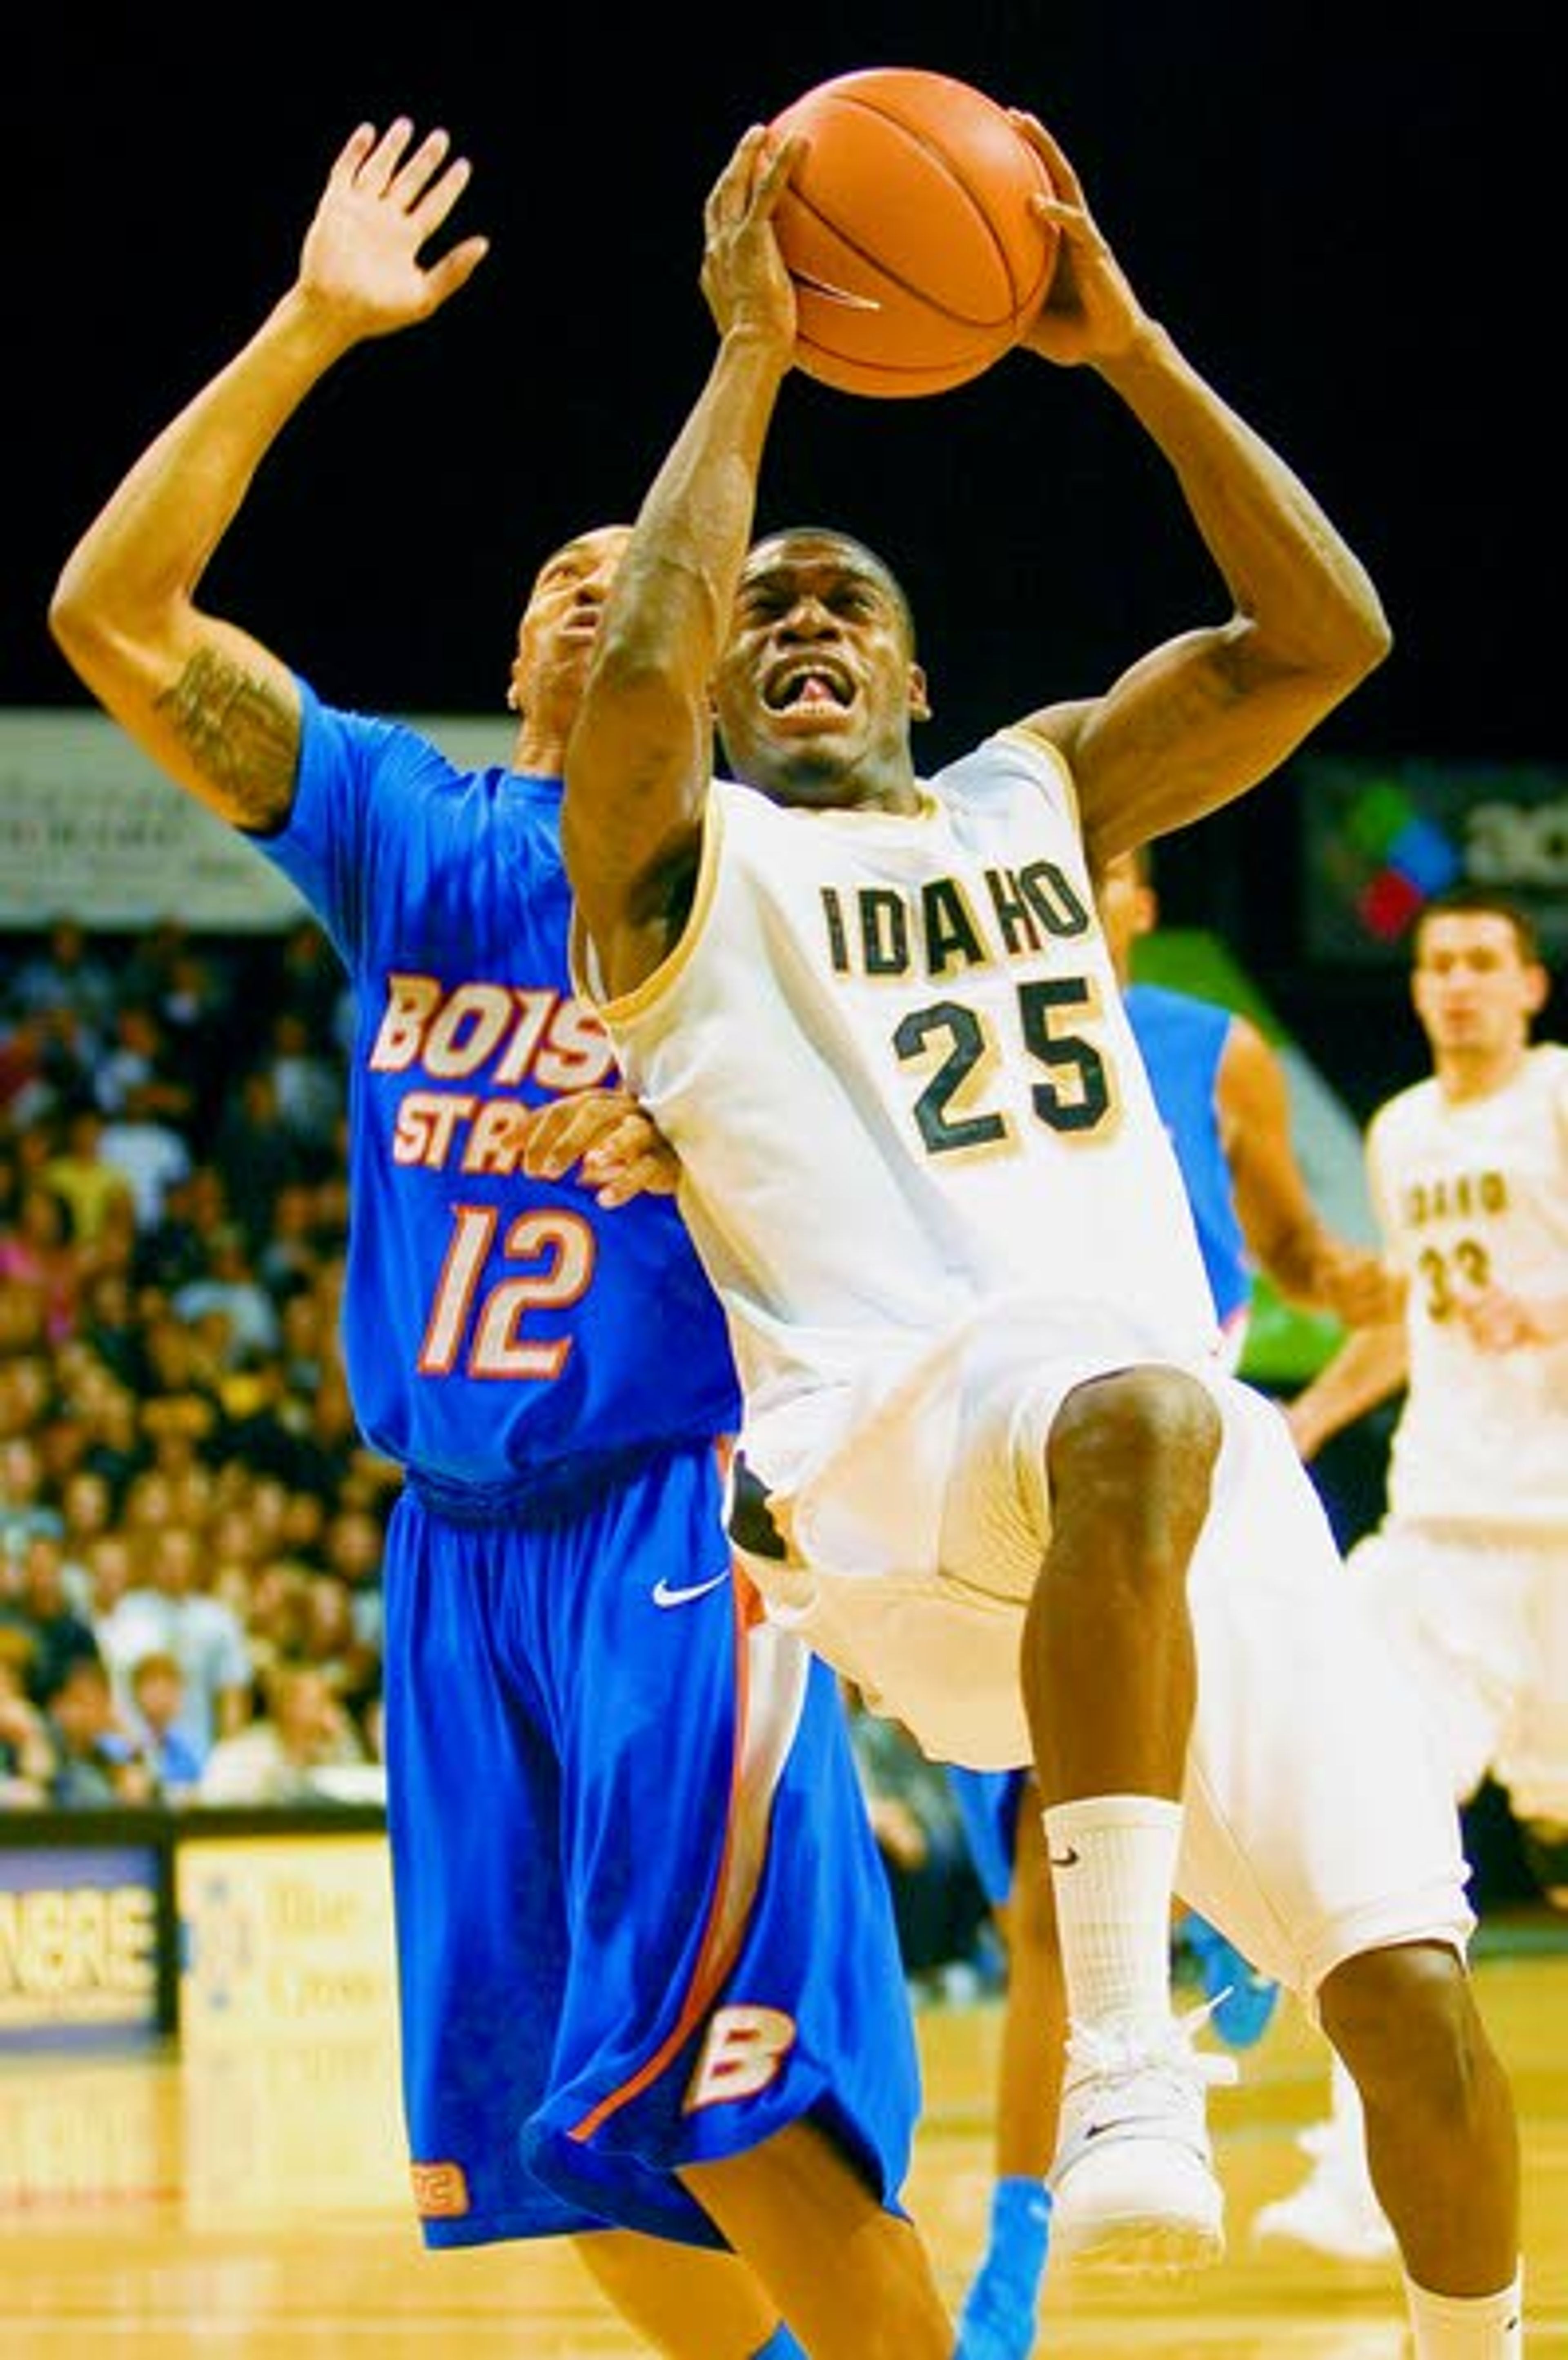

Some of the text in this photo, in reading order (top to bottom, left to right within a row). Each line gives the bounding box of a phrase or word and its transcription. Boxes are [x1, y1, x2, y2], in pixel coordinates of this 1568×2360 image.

[819, 859, 1091, 979] IDAHO
[368, 973, 615, 1091] BOIS
[891, 976, 1121, 1166] 25
[392, 1090, 600, 1186] STA
[416, 1203, 596, 1379] 12
[681, 2003, 796, 2116] B
